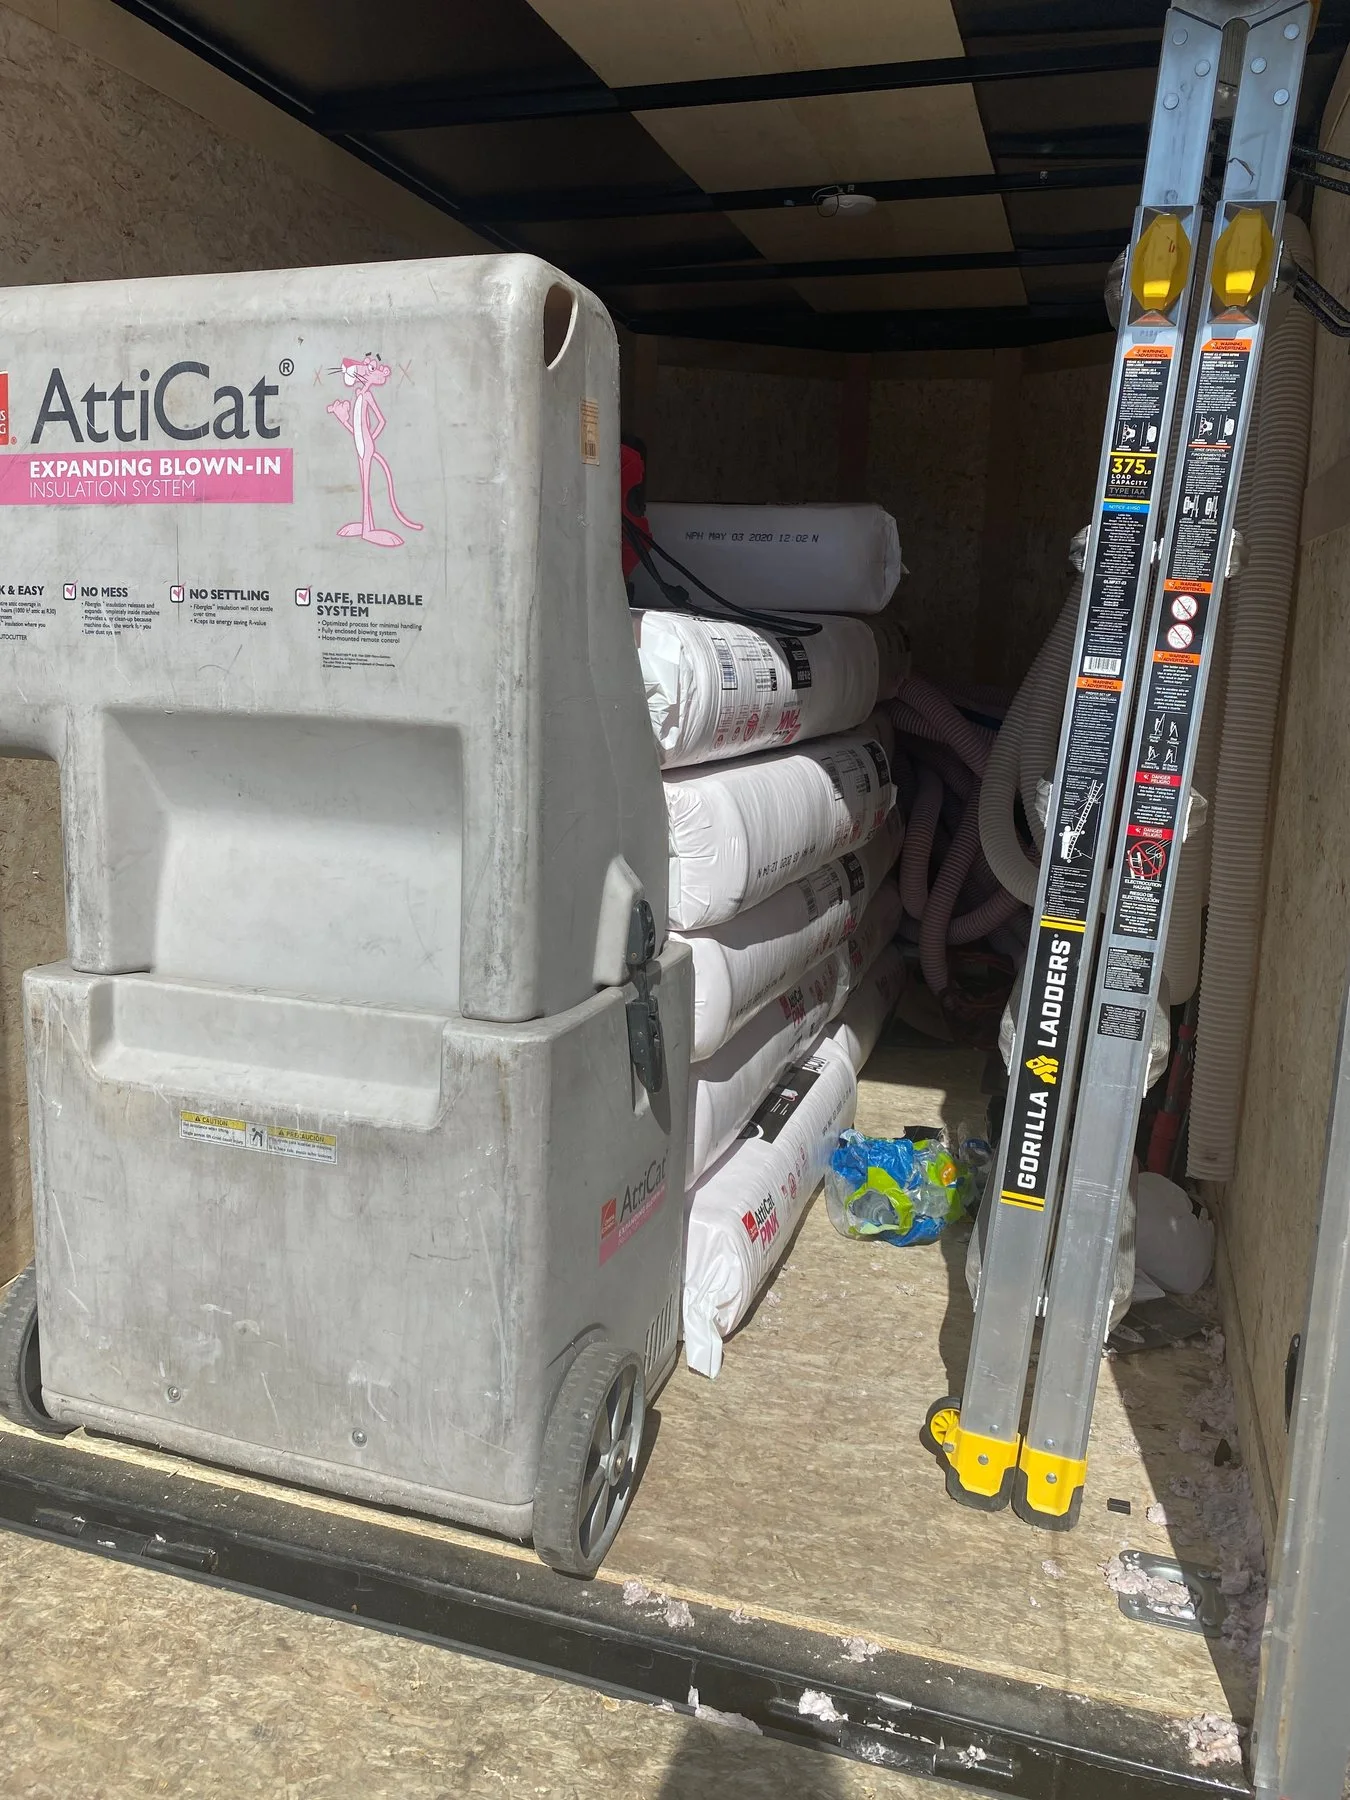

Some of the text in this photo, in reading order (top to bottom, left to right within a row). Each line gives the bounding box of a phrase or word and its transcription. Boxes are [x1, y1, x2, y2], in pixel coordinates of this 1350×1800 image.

[30, 456, 281, 478] EXPANDING BLOWN-IN
[1112, 457, 1146, 475] 375
[29, 478, 196, 498] INSULATION SYSTEM
[708, 532, 727, 541] MAY
[731, 533, 744, 542] 03
[748, 533, 773, 542] 2020
[778, 534, 809, 543] 12:02
[811, 534, 819, 543] N
[7, 585, 15, 595] &
[18, 585, 44, 596] EASY
[81, 587, 128, 598] NO MESS
[189, 588, 270, 601] NO SETTLING
[316, 592, 423, 606] SAFE, RELIABLE
[316, 605, 369, 617] SYSTEM
[321, 619, 348, 627] Optimized
[400, 622, 422, 631] handling
[321, 627, 333, 635] Fully
[1124, 878, 1162, 888] ELECTROCUTION
[202, 1116, 228, 1126] CAUTION
[1017, 1090, 1049, 1190] GORILLA
[754, 1192, 775, 1229] AttiCat
[759, 1206, 780, 1251] PINK
